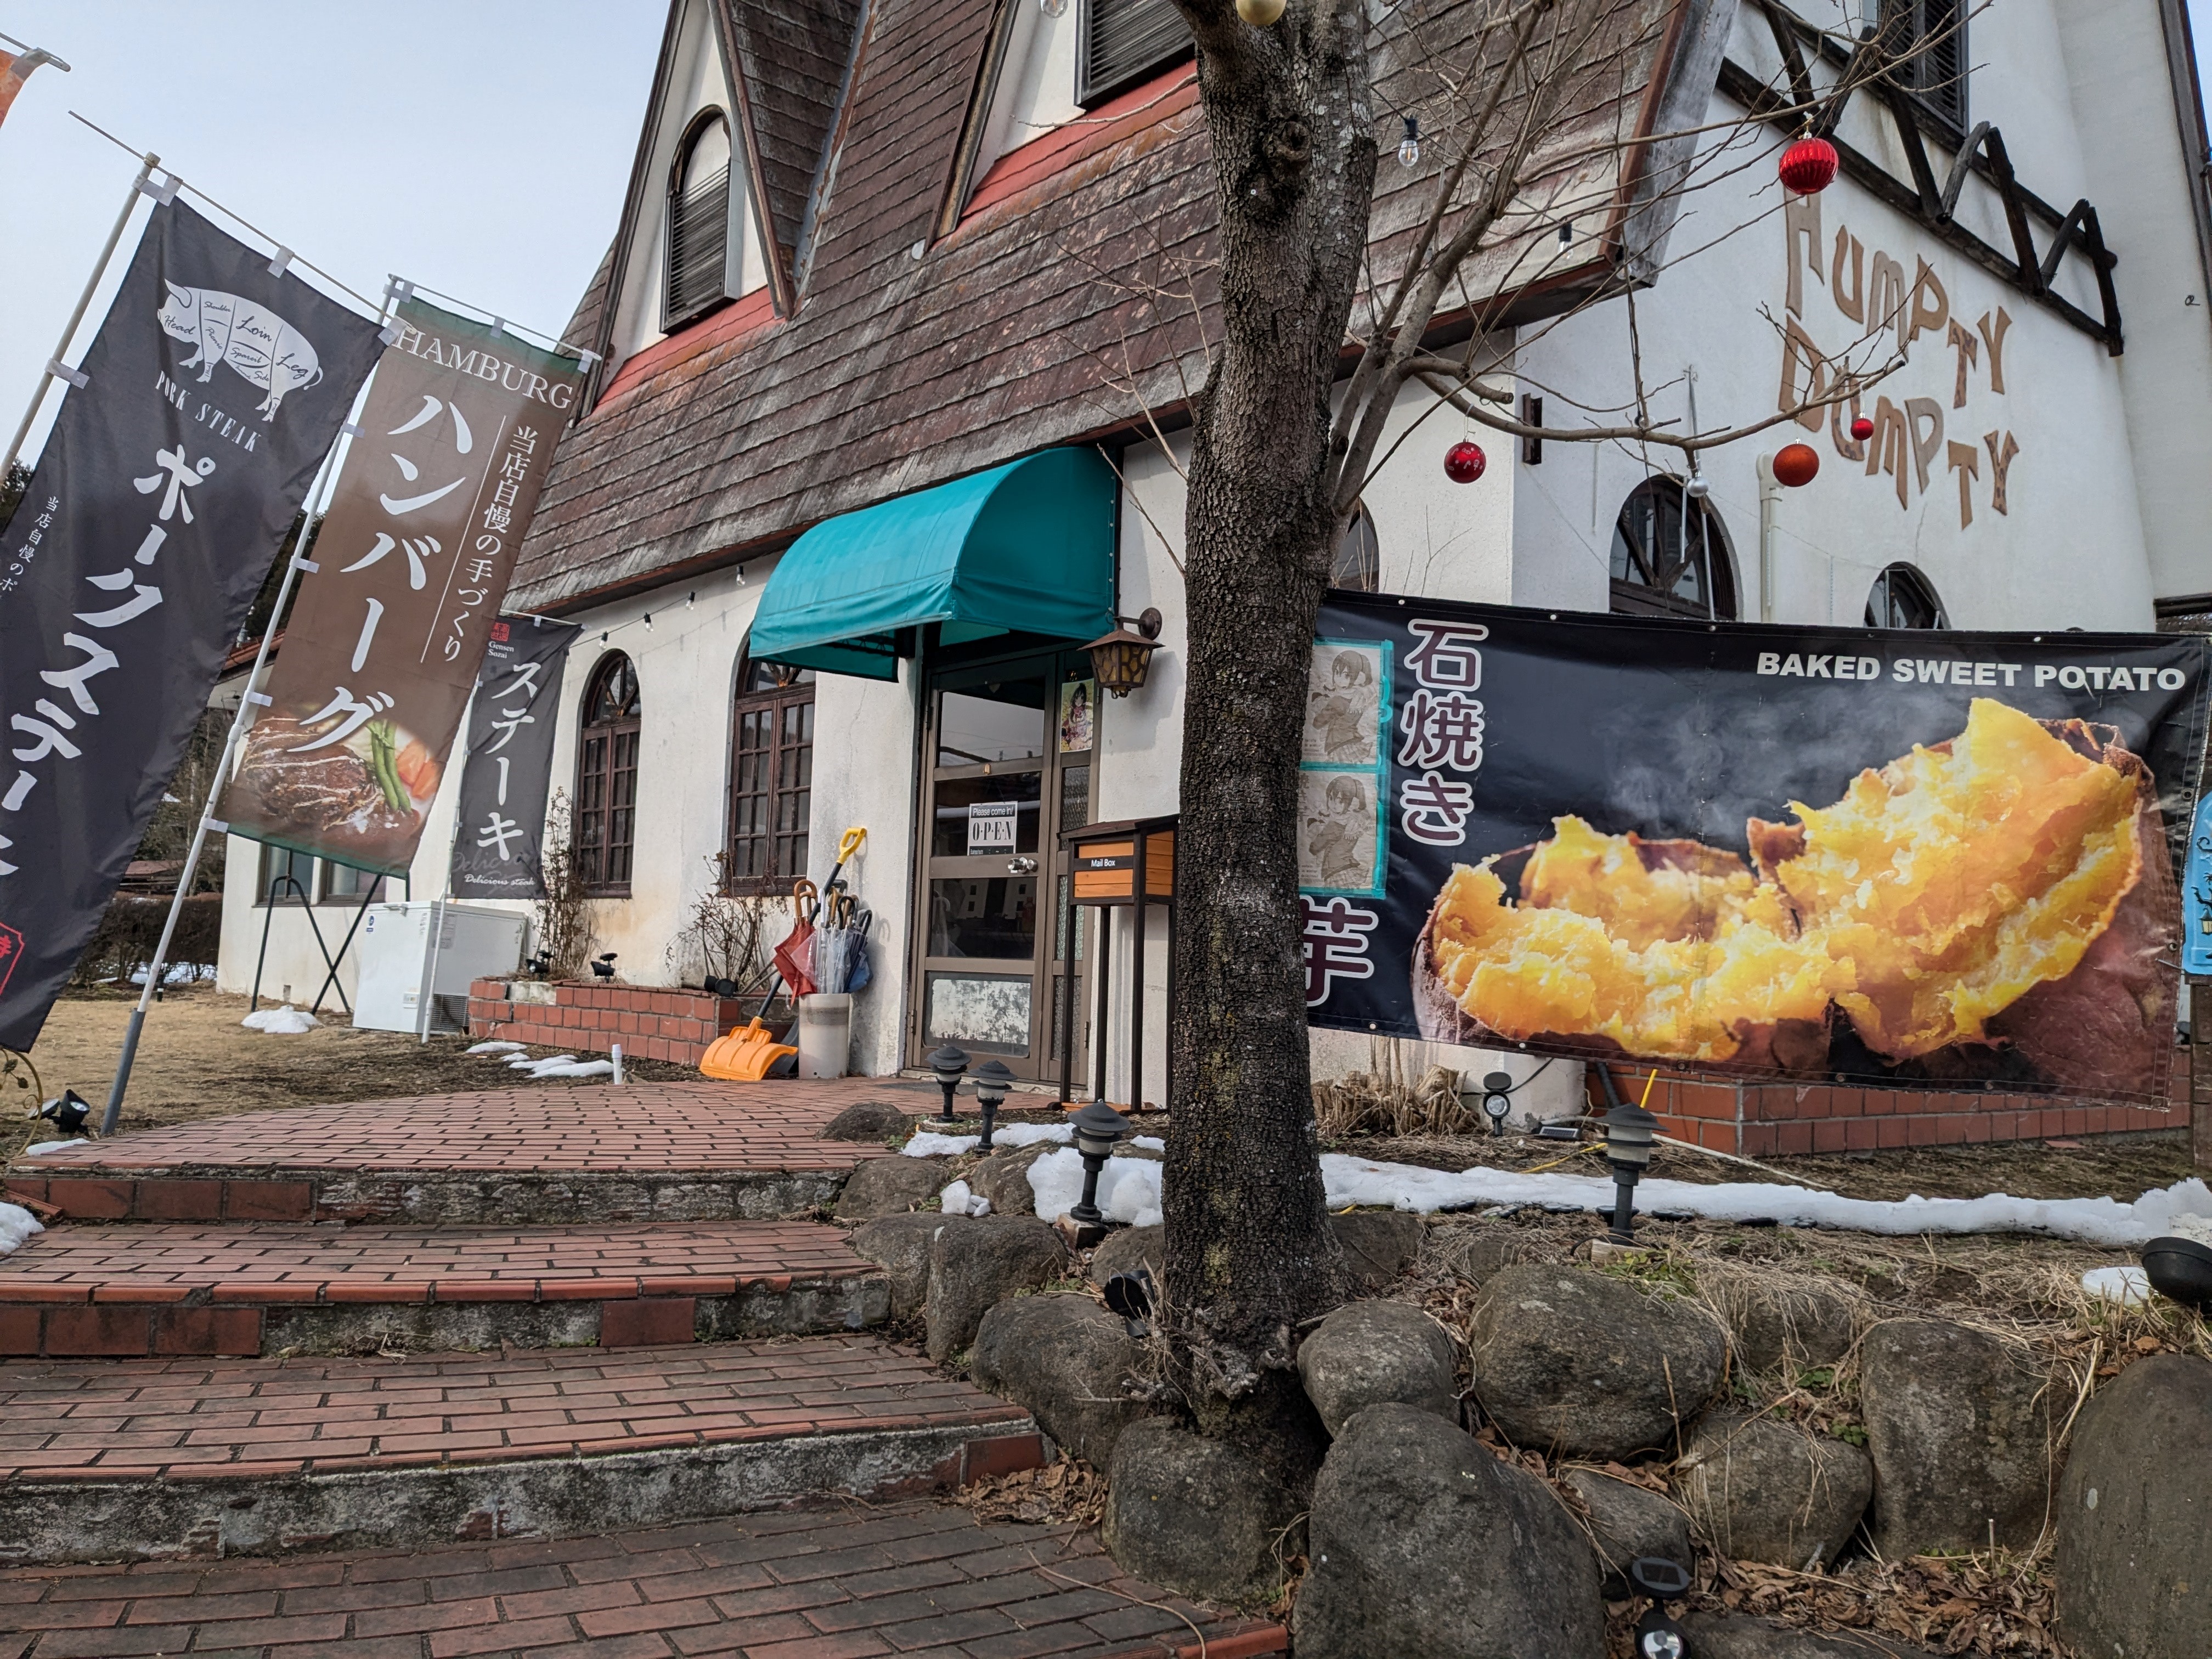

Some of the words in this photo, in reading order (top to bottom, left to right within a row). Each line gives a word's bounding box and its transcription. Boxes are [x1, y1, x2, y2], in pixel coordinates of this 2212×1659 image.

[1784, 184, 2012, 409] HUMPTY
[164, 315, 196, 335] Head
[236, 315, 272, 342] Loin
[253, 371, 269, 381] Side
[276, 353, 308, 380] Leg
[392, 329, 573, 409] HAMBURG
[155, 370, 191, 410] PORK
[195, 403, 262, 452] STEAK
[1778, 313, 2019, 531] DUMPTY
[444, 426, 539, 662] 当店自慢の手づくり
[287, 396, 473, 752] ハンバーグ
[0, 444, 216, 875] ポークステー
[488, 641, 514, 652] Gensen
[488, 648, 507, 658] Sozai
[1757, 652, 1880, 680] BAKED
[1892, 659, 2022, 686] SWEET
[2034, 664, 2186, 691] POTATO
[1397, 618, 1489, 845] 石焼き
[477, 662, 541, 861] ステーキ
[973, 808, 990, 816] Please
[464, 873, 509, 885] Delicious
[511, 877, 535, 885] steak
[1091, 859, 1103, 867] Mail
[1104, 859, 1115, 867] Box
